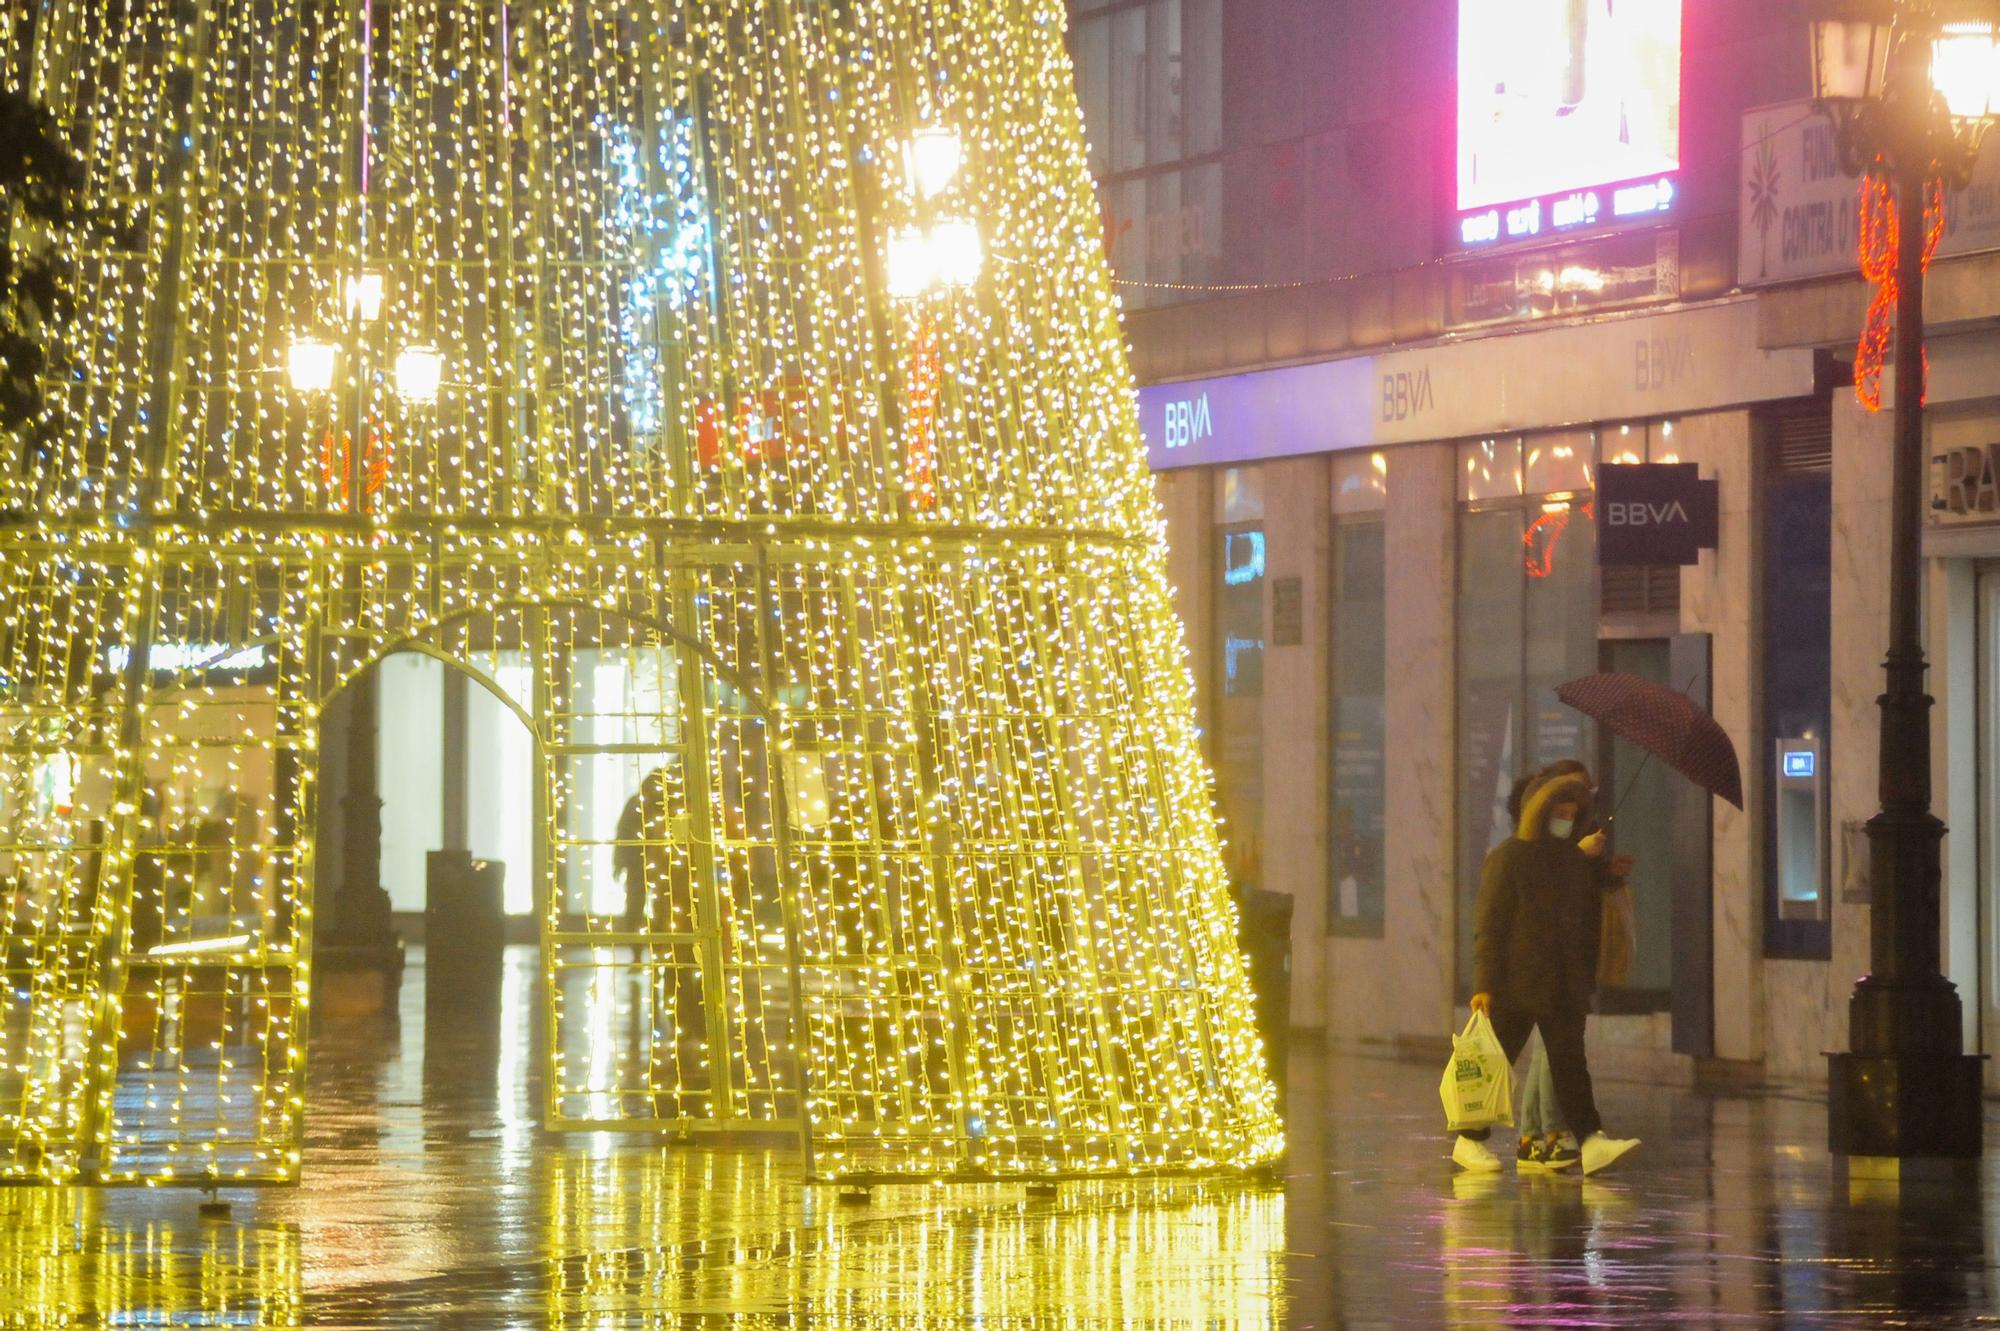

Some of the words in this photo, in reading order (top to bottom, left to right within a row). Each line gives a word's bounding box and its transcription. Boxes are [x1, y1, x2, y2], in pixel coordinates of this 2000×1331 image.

[1635, 337, 1697, 391] BBVA
[1165, 392, 1212, 448] BBVA
[1382, 364, 1434, 422] BBVA
[1609, 501, 1688, 525] BBVA
